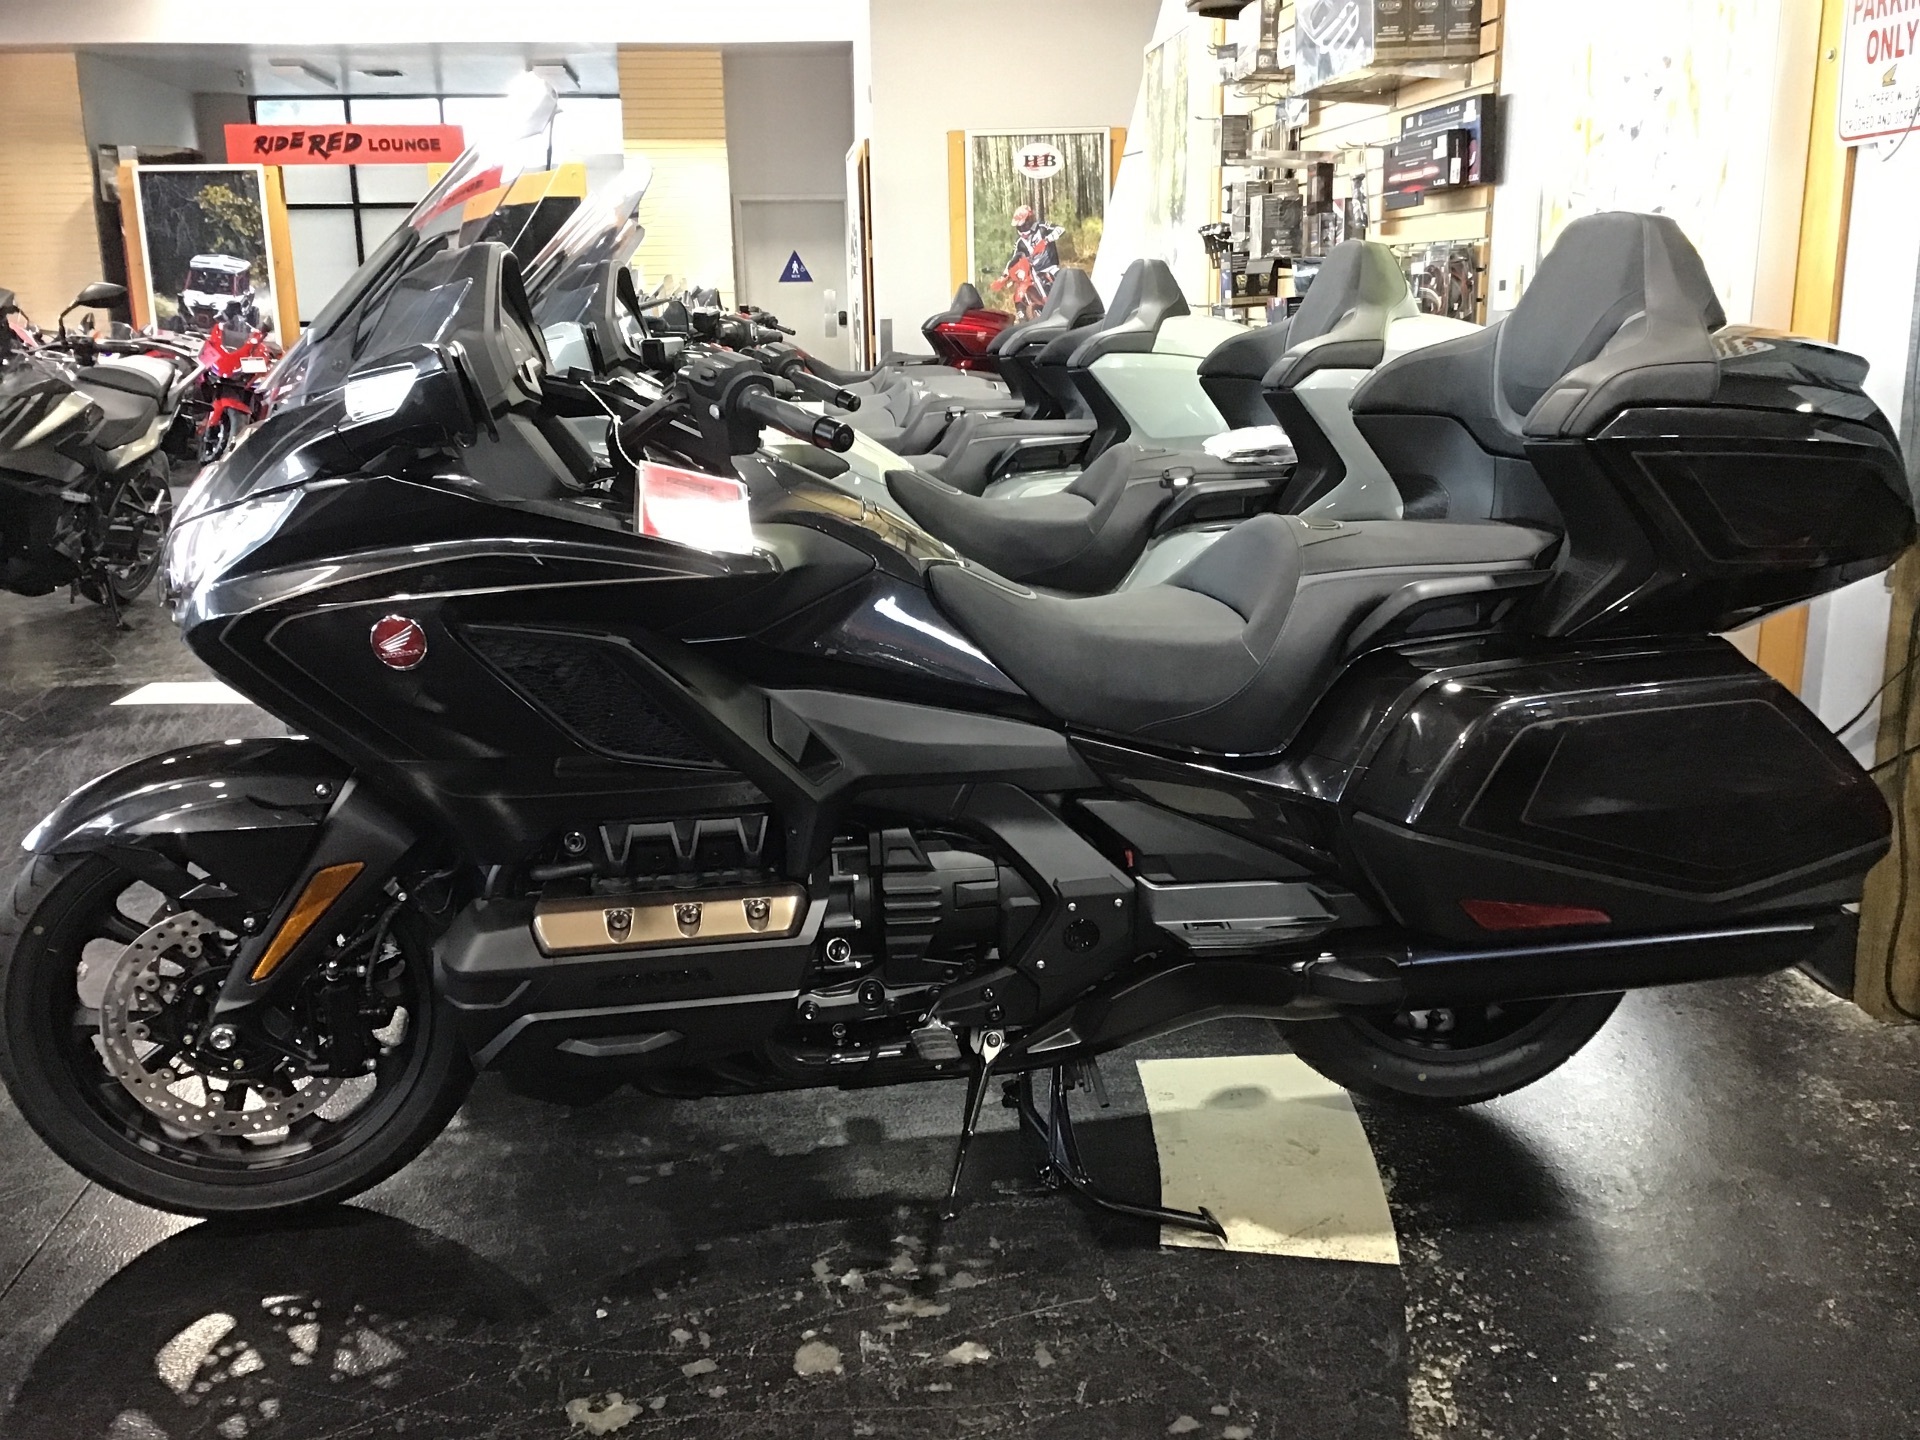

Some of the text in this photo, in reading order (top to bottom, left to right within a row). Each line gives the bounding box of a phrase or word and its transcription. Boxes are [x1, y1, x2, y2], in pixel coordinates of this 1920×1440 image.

[1852, 0, 1920, 25] PARK
[1867, 19, 1919, 64] ONLY
[254, 131, 441, 160] RIDE RED LOUNGE
